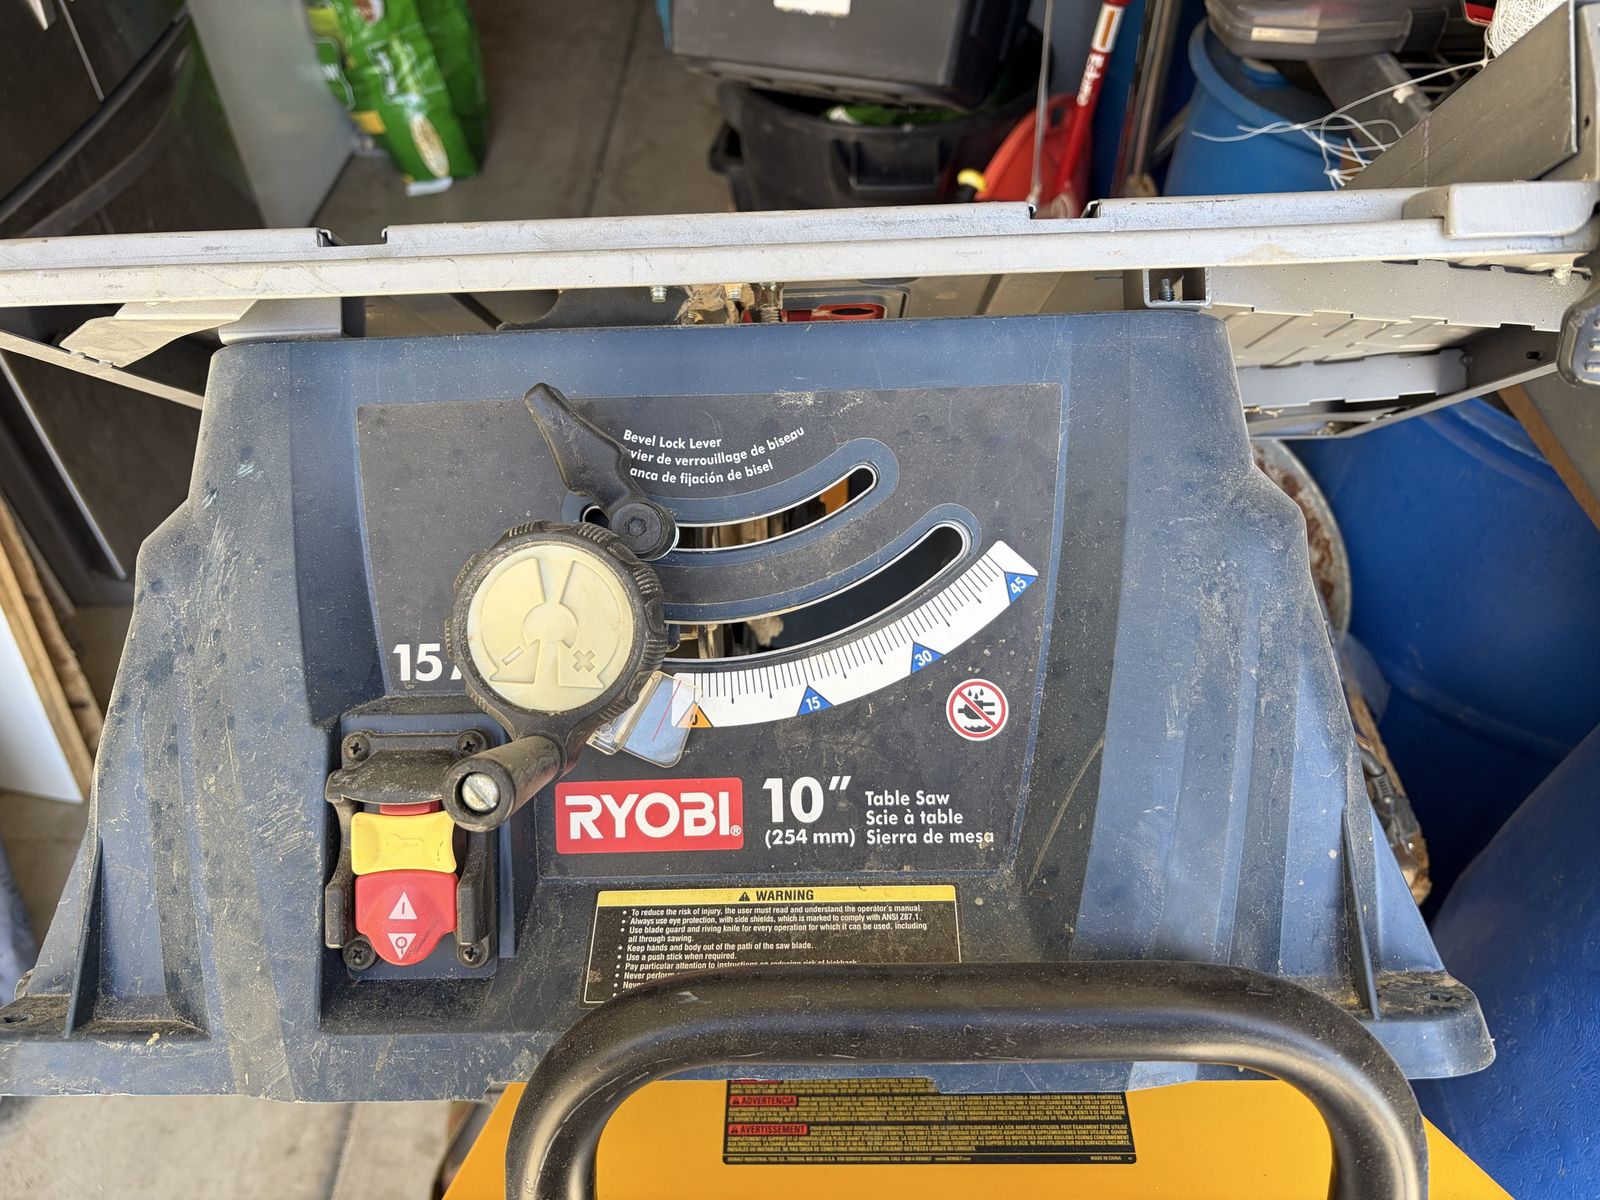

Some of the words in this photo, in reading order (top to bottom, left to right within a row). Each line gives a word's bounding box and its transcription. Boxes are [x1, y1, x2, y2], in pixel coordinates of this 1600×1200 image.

[623, 429, 656, 446] Bevel
[660, 436, 686, 449] Lock
[690, 438, 722, 449] Lever
[628, 449, 654, 462] vier
[656, 452, 672, 465] de
[675, 450, 748, 466] verrouillage
[750, 444, 766, 457] de
[766, 426, 805, 450] biseau
[630, 467, 658, 480] anca
[662, 471, 676, 483] de
[680, 472, 724, 487] fijación
[727, 469, 742, 482] de
[746, 459, 774, 478] bisel
[1010, 577, 1027, 594] 45
[392, 643, 443, 682] 15
[914, 650, 932, 666] 30
[806, 696, 822, 711] 15
[865, 790, 910, 806] Table
[916, 790, 950, 805] Saw
[866, 810, 898, 825] Scie
[904, 809, 914, 825] à
[920, 808, 964, 824] table
[765, 828, 808, 848] (254
[813, 828, 856, 847] mm)
[866, 828, 917, 845] Sierra
[923, 828, 944, 844] de
[950, 831, 994, 844] mesa
[756, 890, 814, 901] WARNING
[631, 908, 640, 916] To
[640, 908, 665, 916] reduce
[666, 908, 677, 916] the
[724, 907, 736, 915] the
[754, 906, 771, 914] must
[772, 906, 789, 914] read
[789, 906, 804, 914] and
[804, 905, 843, 913] understand
[844, 905, 856, 913] the
[894, 904, 923, 912] manual.
[630, 917, 654, 927] Always
[668, 918, 681, 926] eye
[718, 916, 734, 924] with
[777, 915, 798, 923] which
[806, 914, 832, 922] marked
[832, 914, 840, 922] to
[840, 914, 865, 923] comply
[866, 913, 881, 921] with
[881, 913, 899, 921] ANSI
[629, 926, 643, 934] Use
[665, 925, 685, 935] guard
[686, 925, 701, 933] and
[701, 925, 722, 934] riving
[741, 924, 751, 932] for
[752, 925, 772, 934] every
[774, 924, 807, 933] operation
[808, 923, 818, 931] for
[819, 923, 841, 931] which
[841, 923, 848, 931] it
[894, 922, 928, 931] including
[628, 935, 638, 943] all
[638, 935, 666, 944] through
[666, 934, 695, 944] sawing.
[627, 944, 645, 953] Keep
[646, 944, 668, 952] hands
[684, 943, 701, 953] body
[702, 943, 714, 951] out
[715, 943, 723, 951] of
[736, 943, 753, 952] path
[754, 942, 762, 950] of
[762, 942, 774, 950] the
[626, 953, 640, 961] Use
[647, 953, 665, 963] push
[666, 953, 683, 961] stick
[684, 952, 704, 960] when
[704, 952, 737, 962] required.
[624, 963, 638, 972] Pay
[640, 962, 674, 972] particular
[675, 961, 707, 969] attention
[708, 961, 715, 969] to
[741, 1096, 795, 1104] ADVERTENCIA
[740, 1124, 805, 1134] AVERTISSEMENT
